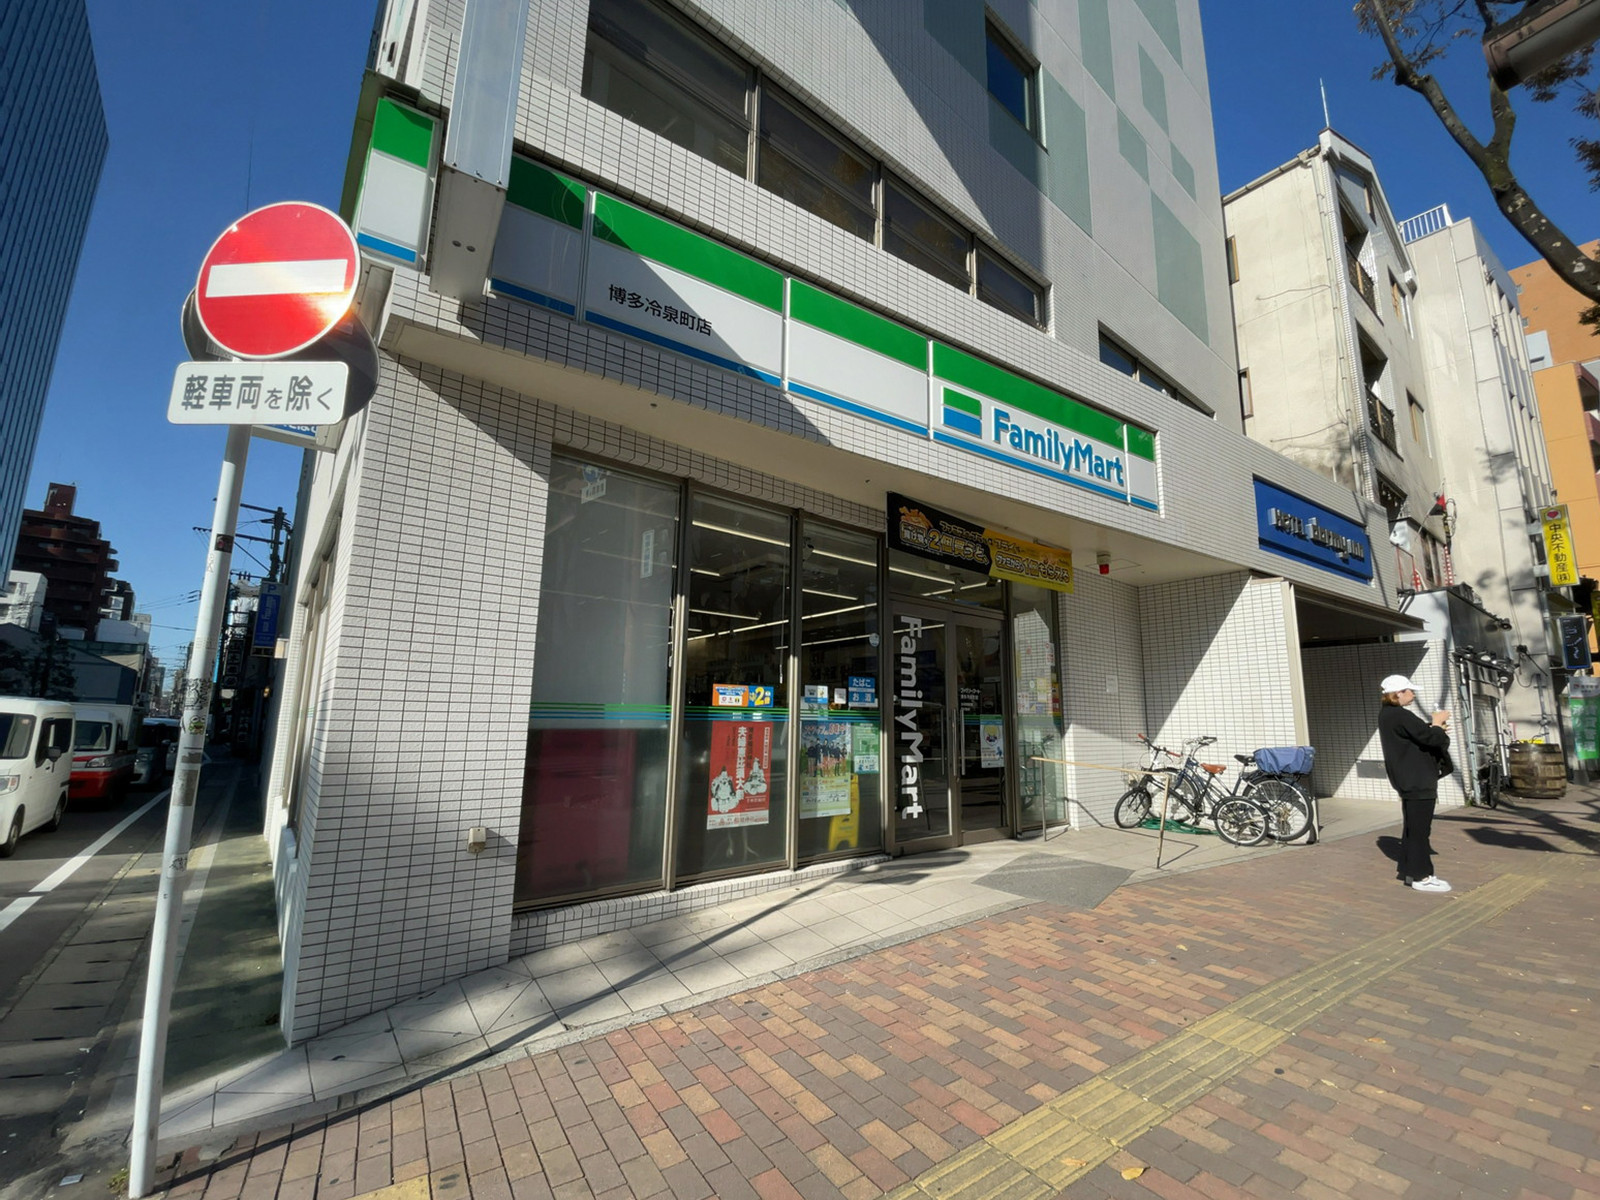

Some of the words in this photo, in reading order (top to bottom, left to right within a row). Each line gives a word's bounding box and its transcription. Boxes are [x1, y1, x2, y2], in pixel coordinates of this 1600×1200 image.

[608, 284, 713, 336] 博多冷泉町店
[181, 374, 333, 412] 軽車両を除く
[992, 406, 1125, 487] FamilyMart
[267, 584, 277, 593] P
[852, 678, 871, 688] たばこ
[895, 615, 924, 820] FamilyMart
